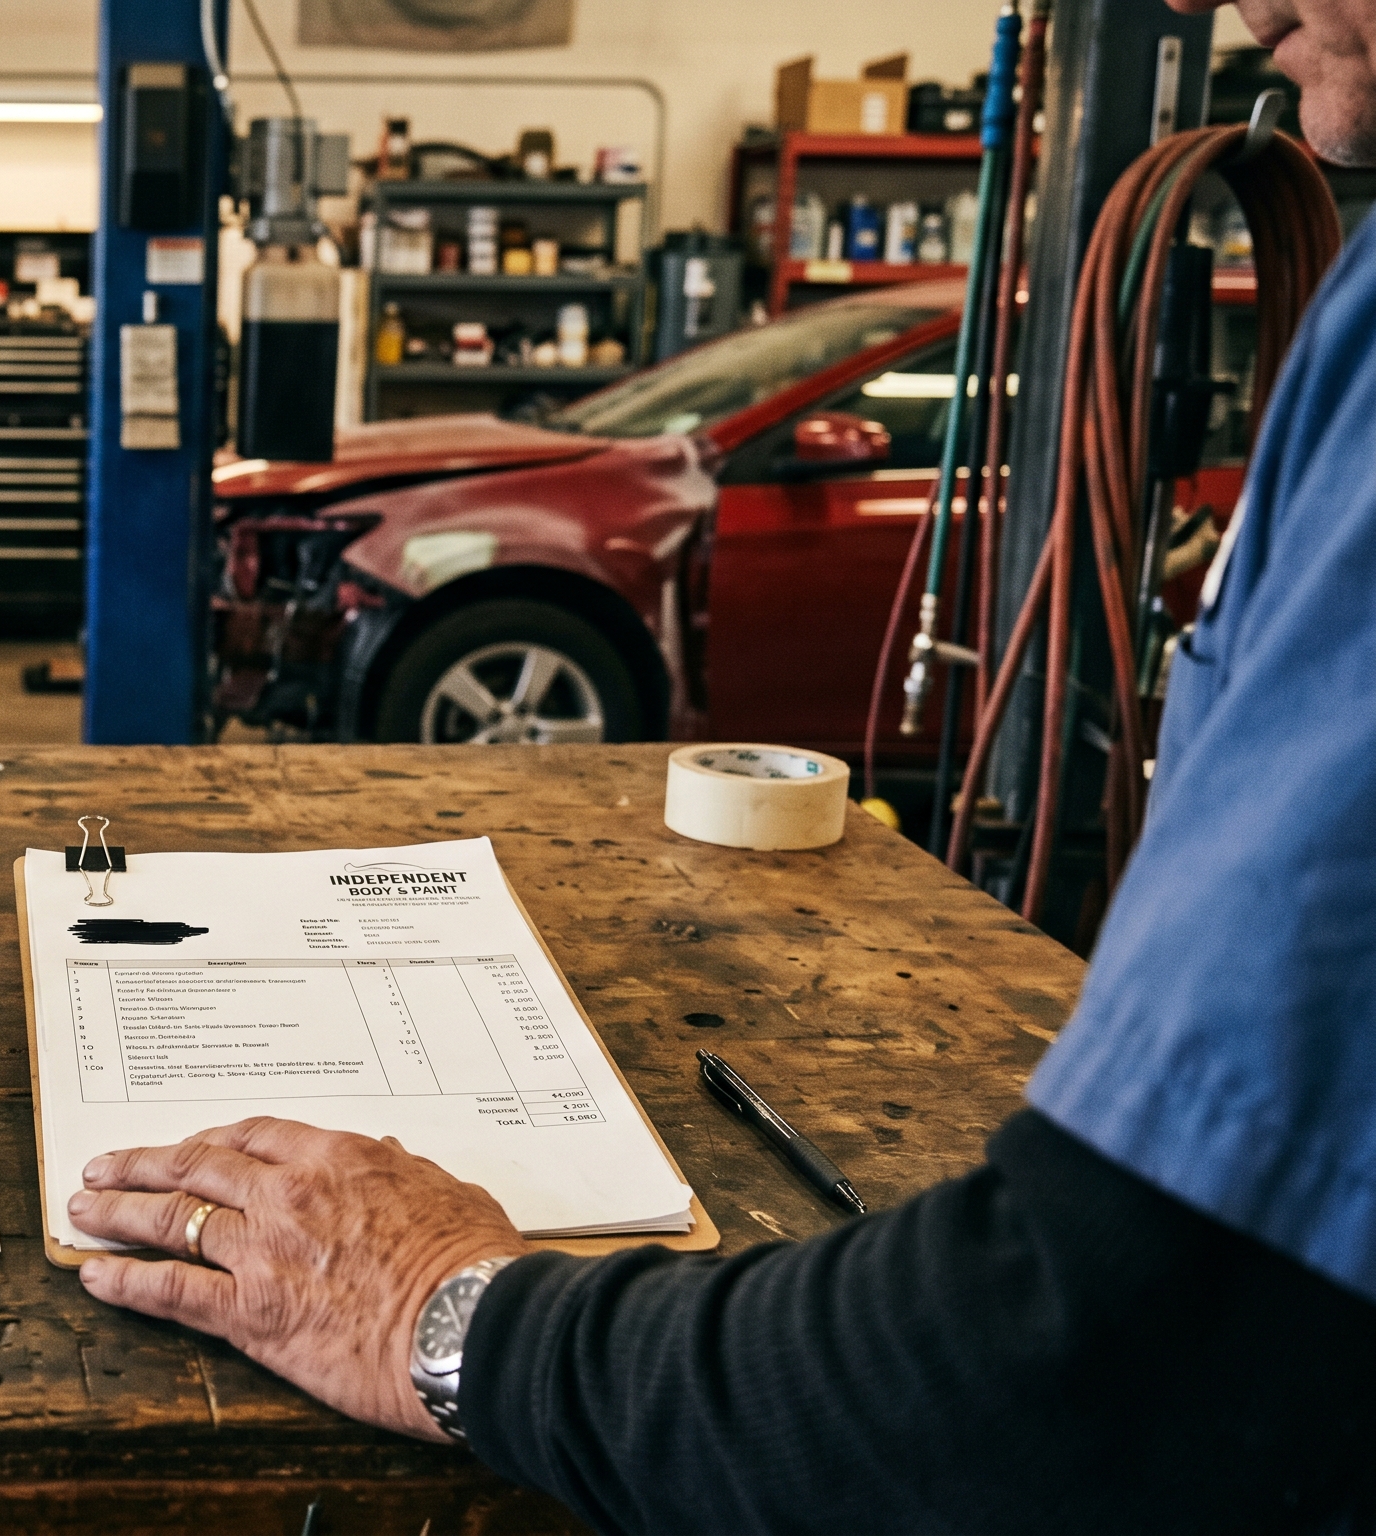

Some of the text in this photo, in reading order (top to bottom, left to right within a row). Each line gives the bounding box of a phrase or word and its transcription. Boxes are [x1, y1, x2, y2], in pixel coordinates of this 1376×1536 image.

[330, 872, 466, 886] INDEPENDENT
[349, 887, 391, 896] BODY
[411, 885, 457, 894] PAINT
